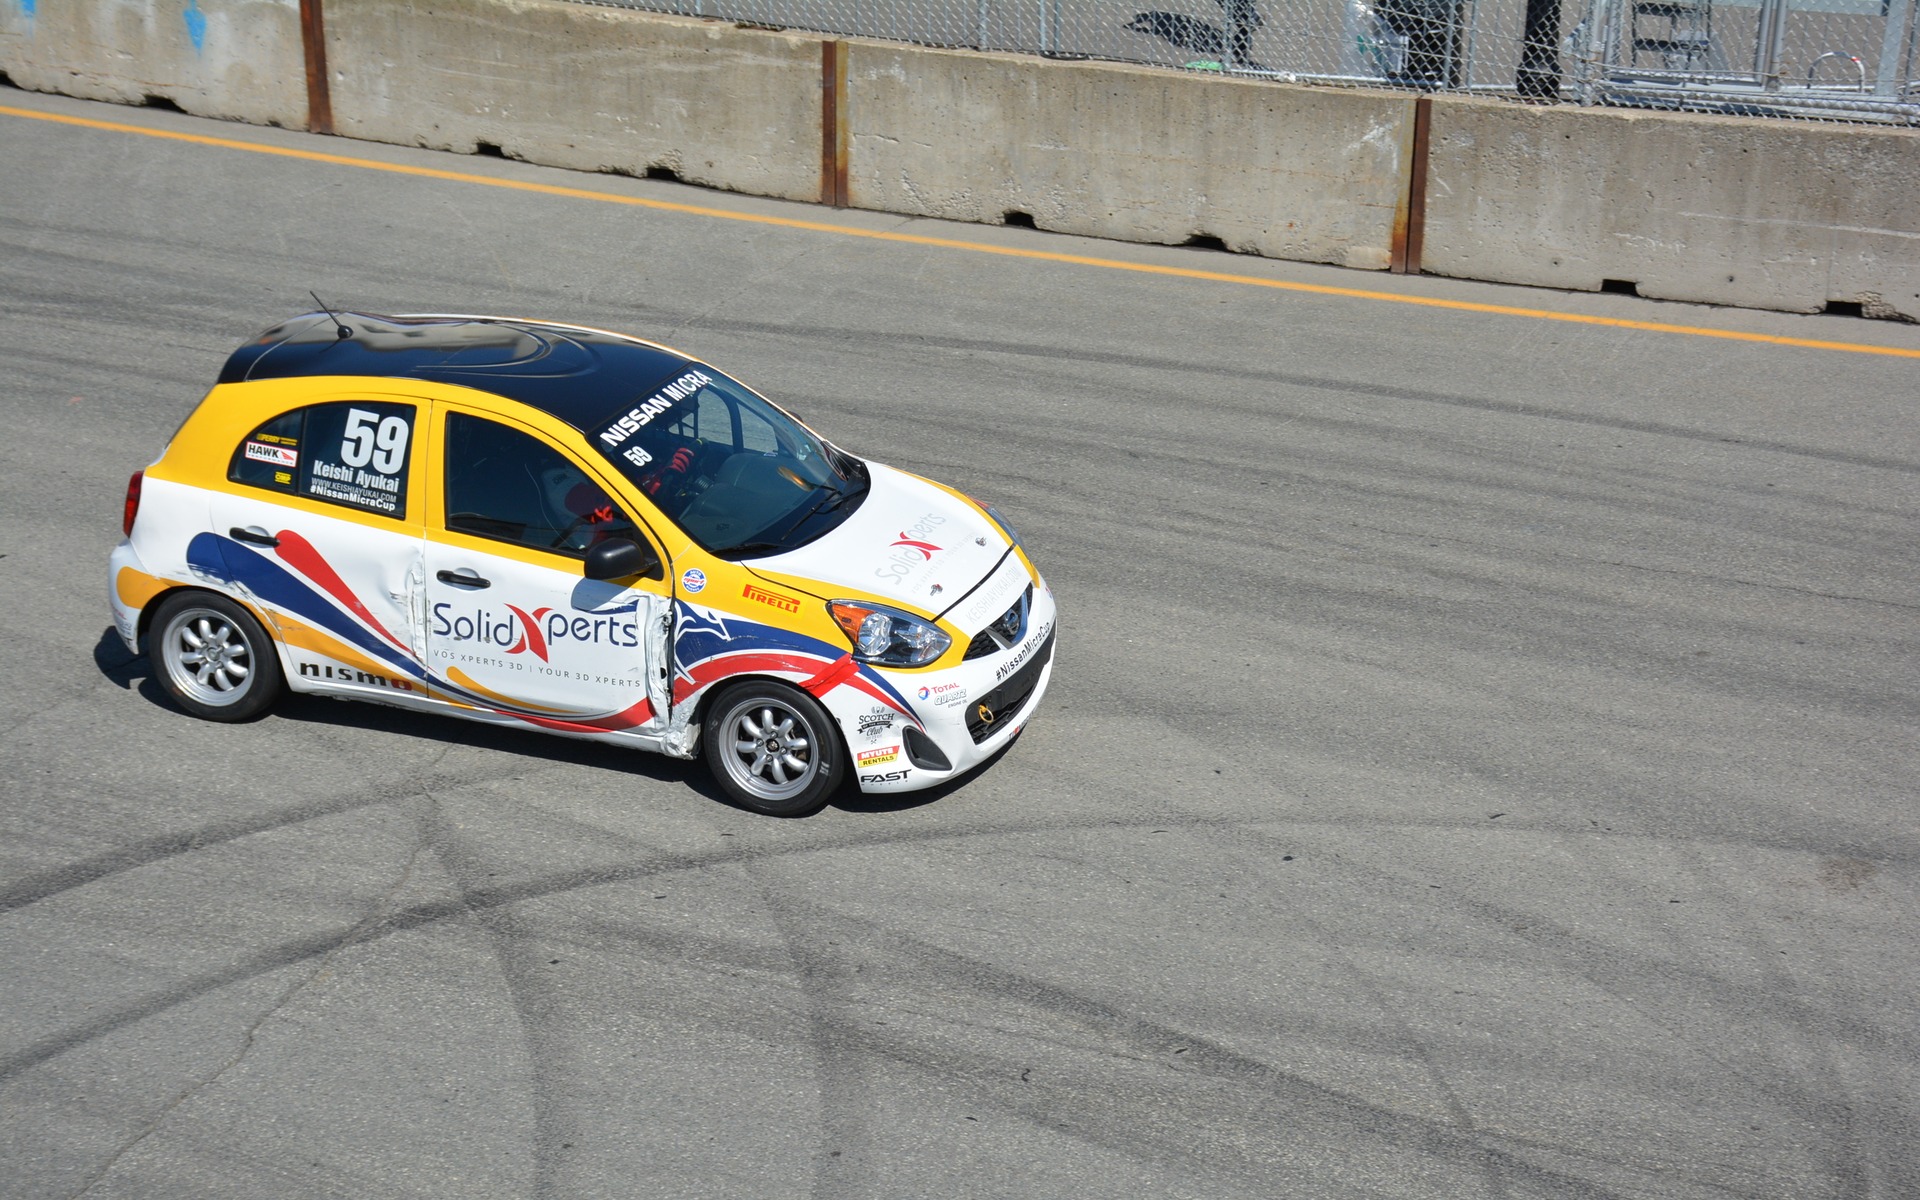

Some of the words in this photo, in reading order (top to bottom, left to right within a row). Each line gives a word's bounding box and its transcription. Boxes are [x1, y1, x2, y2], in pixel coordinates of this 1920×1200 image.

[600, 394, 672, 447] NISSAN
[662, 370, 713, 401] MICRA
[248, 443, 279, 459] HAWK
[340, 408, 409, 475] 59
[623, 446, 653, 467] 59
[312, 460, 354, 483] Keishi
[355, 470, 400, 493] Ayukai
[310, 484, 396, 511] #NissanMicraCup
[311, 477, 397, 504] WWW.KEISHIAYUKAI.COM
[742, 583, 801, 614] PIRELLI
[995, 621, 1051, 682] #NissanMicraCup
[300, 662, 413, 692] nismo
[433, 650, 455, 660] VOS
[460, 655, 503, 668] XPERTS
[509, 661, 524, 671] 3D
[538, 666, 570, 679] YOUR
[575, 672, 590, 682] 3D
[595, 675, 642, 688] XPERTS
[931, 682, 960, 695] TOTAL
[934, 689, 967, 706] QUARTZ
[858, 713, 895, 725] SCOTCH
[862, 756, 895, 766] RENTALS
[861, 769, 912, 783] FAST
